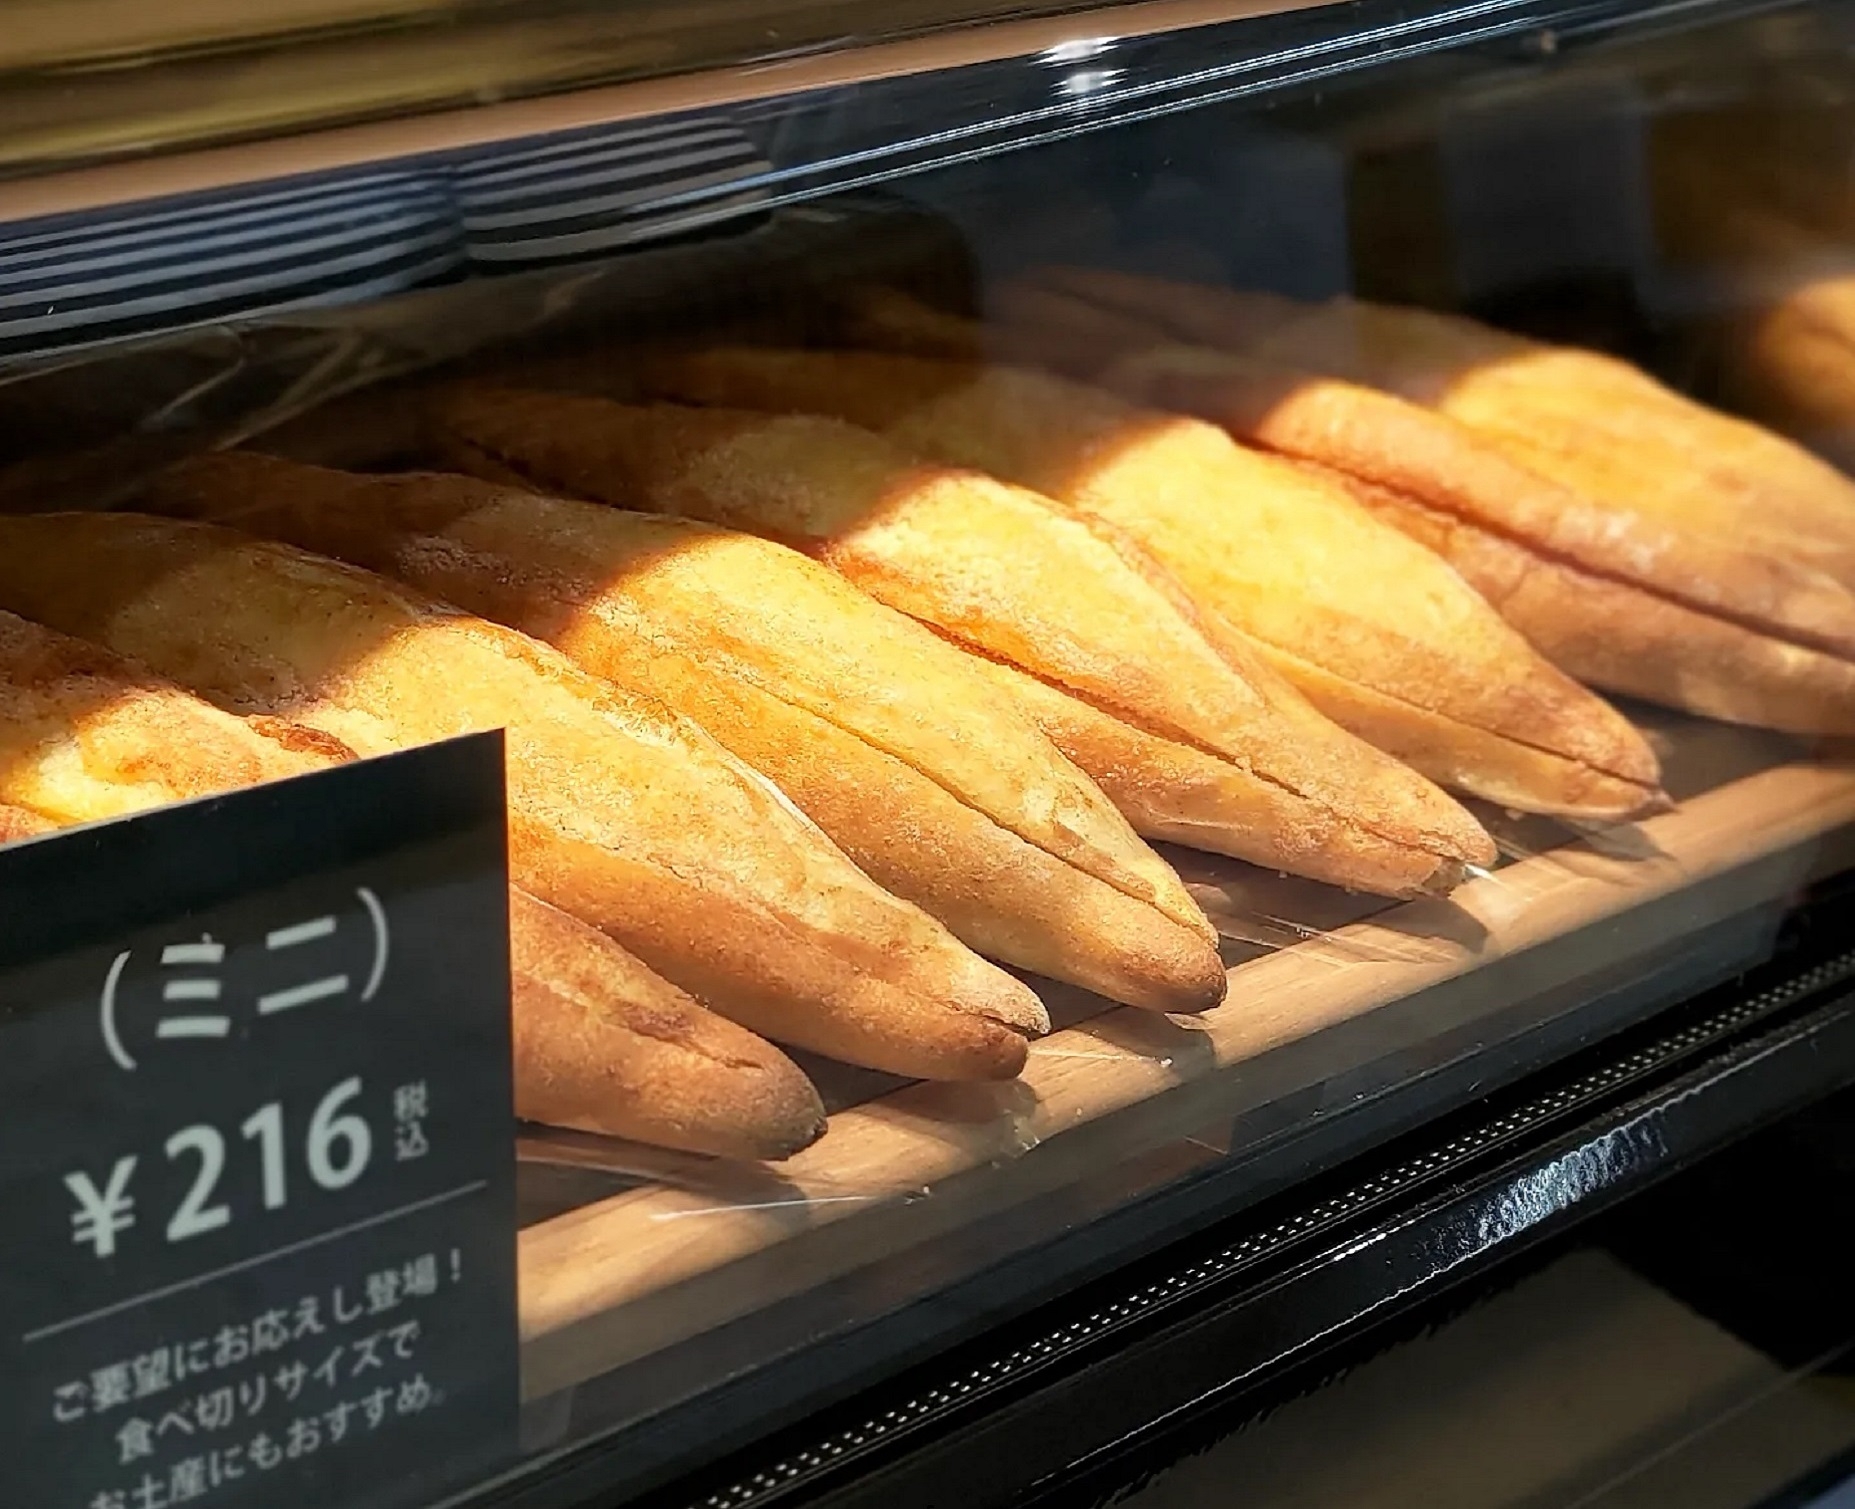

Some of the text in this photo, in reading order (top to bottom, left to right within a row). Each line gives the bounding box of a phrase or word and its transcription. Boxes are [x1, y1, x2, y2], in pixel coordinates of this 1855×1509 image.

[62, 1075, 373, 1259] ¥216
[393, 1078, 430, 1162] 税込
[115, 1319, 421, 1465] 食べ切りサイズで
